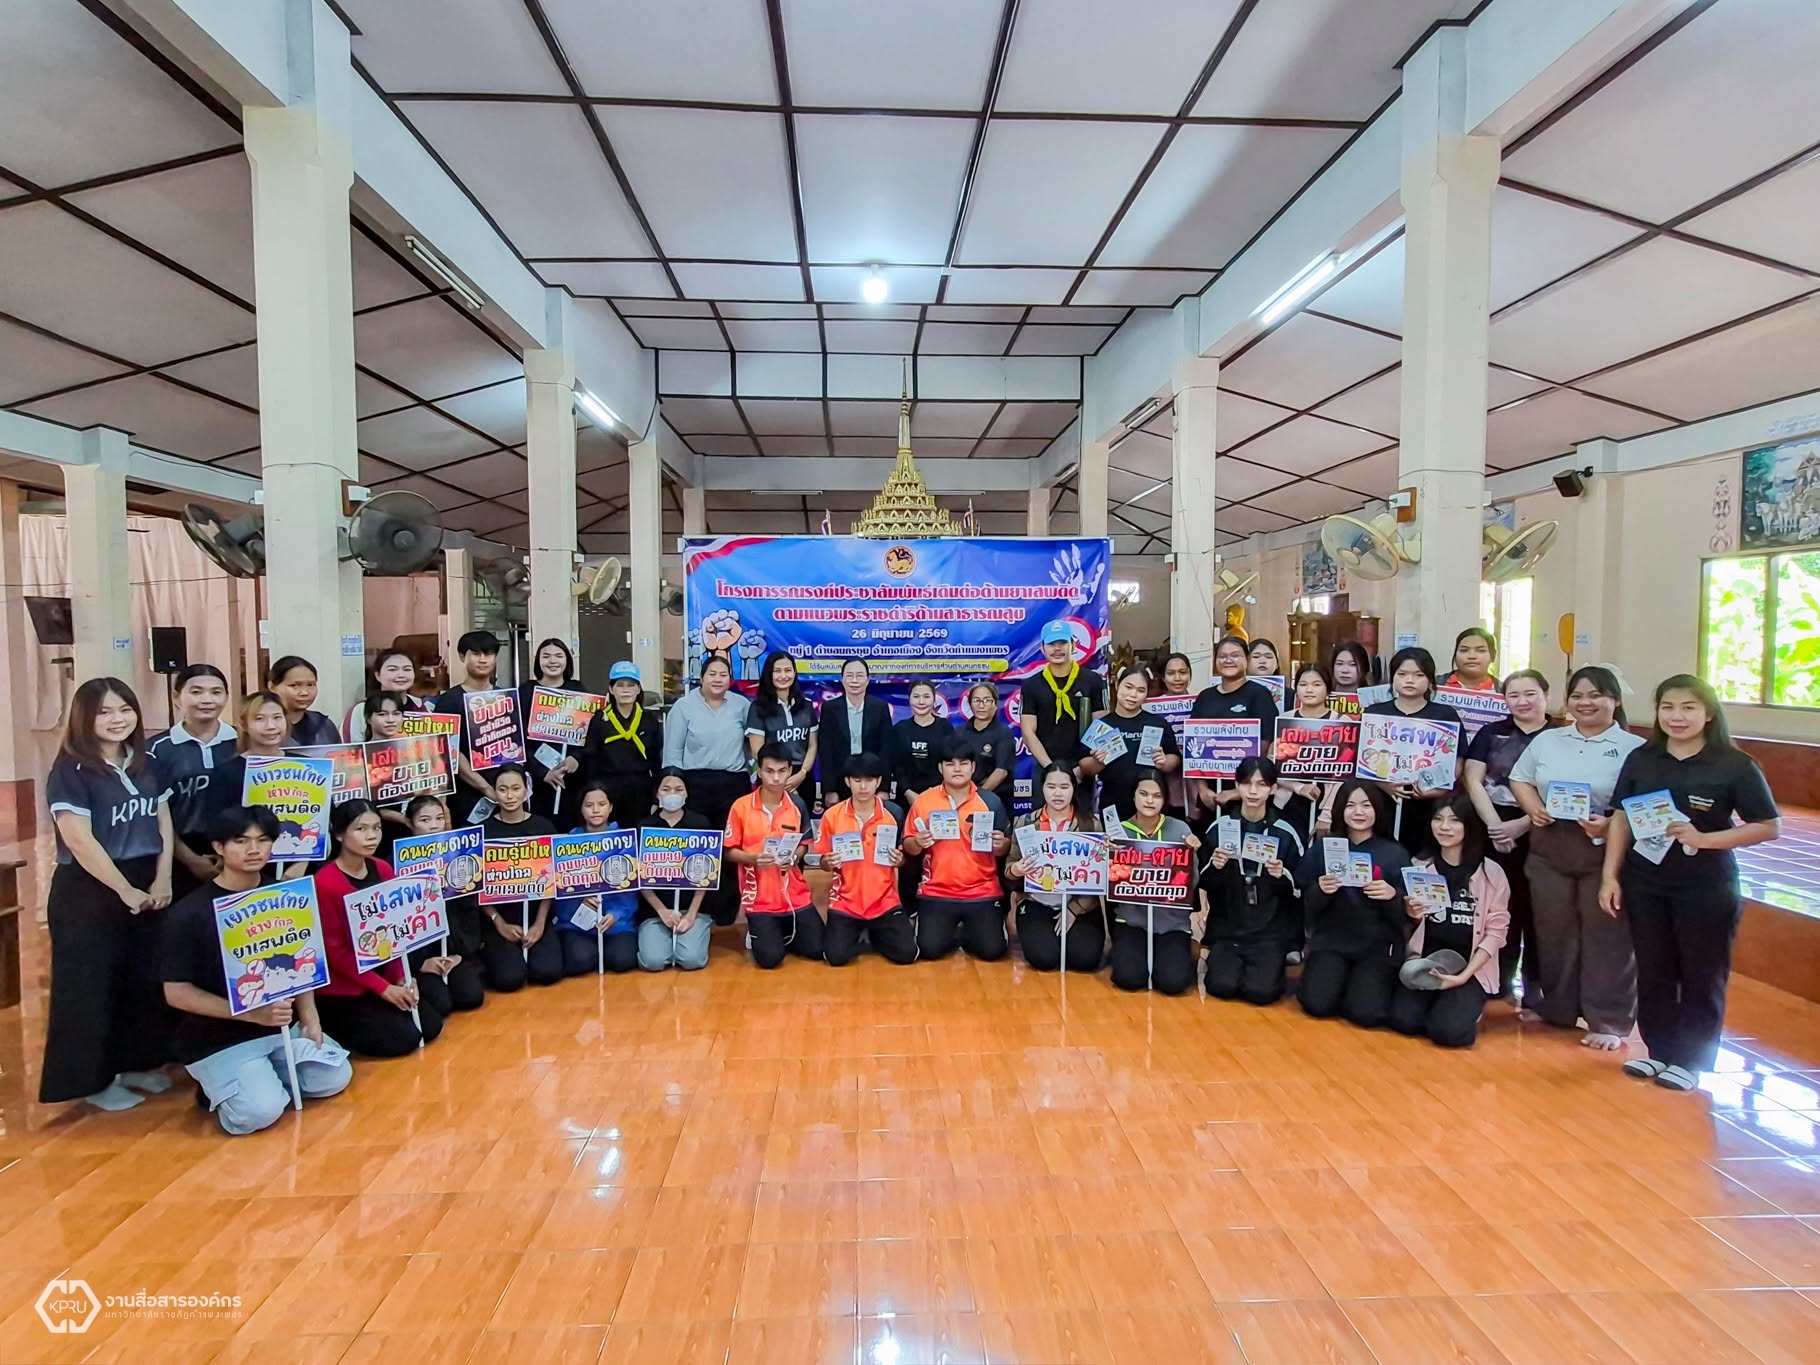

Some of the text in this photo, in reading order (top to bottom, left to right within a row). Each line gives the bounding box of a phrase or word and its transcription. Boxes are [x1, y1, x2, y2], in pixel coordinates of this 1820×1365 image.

[716, 580, 1080, 599] โครงการรณรงค์ประชาสัมพันธ์เดินต่อต้านยาเสพติด
[773, 606, 1025, 623] ตามแนวพระราชดำริด้านสาธารณสุข
[852, 628, 948, 641] 26 มิถุนายน 2569
[805, 645, 812, 656] 1
[815, 643, 870, 658] ตำบลนครชุม
[872, 643, 922, 656] อำเภอเมือง
[924, 643, 1009, 656] จังหวัดกำแพงเพชร
[473, 696, 514, 725] ยาบ้า
[538, 694, 601, 713] คนรุ่นใหม่
[1151, 699, 1192, 711] รวมพลังไ
[397, 716, 455, 735] รุ่นใหม่
[1194, 724, 1249, 735] รวมพลังไทย
[777, 727, 808, 743] KPRU
[483, 737, 512, 760] เสพ
[1297, 745, 1337, 760] ขาย
[1281, 760, 1352, 776] ต้องติดคุก
[1394, 749, 1435, 772] ไม่ค้
[251, 763, 327, 786] เยาวชนไทย
[392, 760, 431, 782] ขาย
[178, 775, 210, 797] KP
[399, 832, 480, 862] คนเสพตาย
[556, 835, 633, 857] คนเสพตาย
[644, 835, 719, 850] คนเสพตาย
[1039, 838, 1090, 858] ม่เสพ
[485, 841, 550, 865] คนรุ่นให
[643, 851, 683, 863] คนขาย
[557, 856, 598, 872] คนขาย
[1056, 860, 1100, 885] ไม่ค้า
[486, 866, 532, 882] ห่างไกล
[561, 872, 599, 888] ติดคุก
[646, 865, 682, 882] ติดคุก
[1131, 868, 1171, 883] ขาย
[484, 881, 545, 896] ยาเสพติด
[1115, 883, 1187, 901] ต้องติดคุก
[223, 888, 309, 929] เยาวชนไทย
[232, 926, 312, 959] ยาเสพติด
